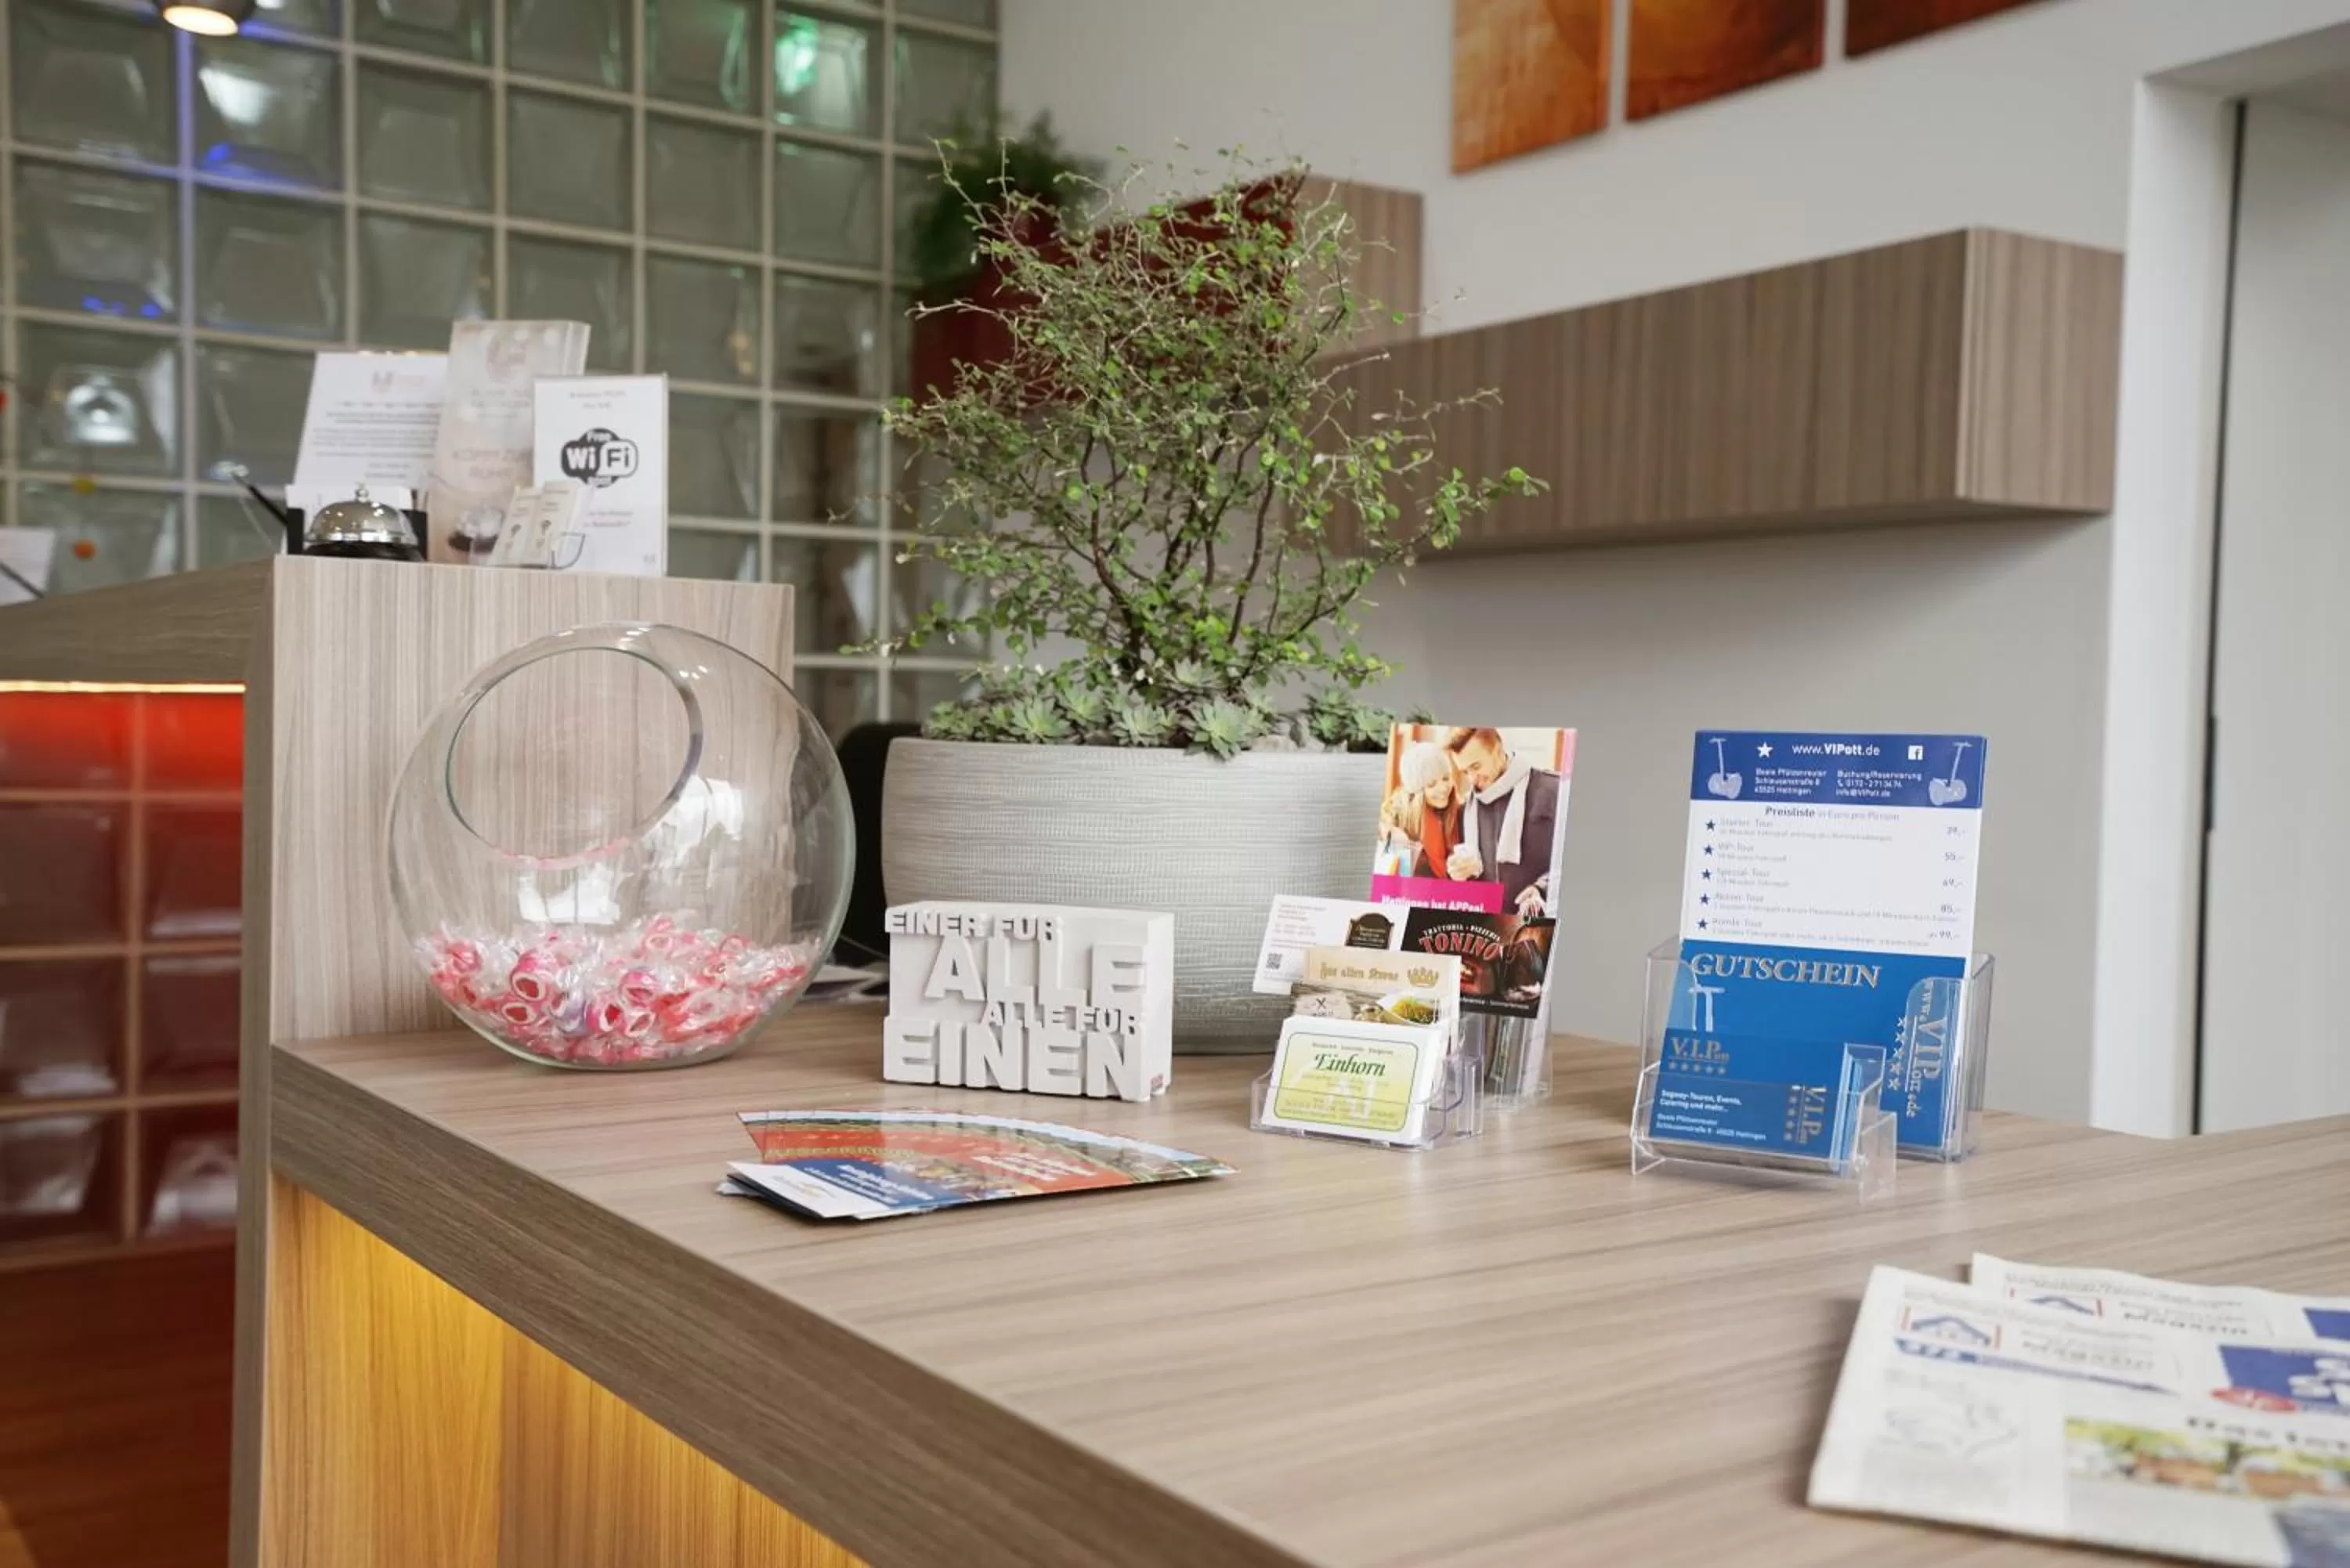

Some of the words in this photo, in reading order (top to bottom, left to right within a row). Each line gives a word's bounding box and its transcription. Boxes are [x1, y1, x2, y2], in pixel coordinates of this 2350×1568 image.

[1791, 742, 1881, 757] www.VIPott.de
[885, 907, 989, 938] EINER
[1419, 931, 1502, 962] TONINO
[924, 934, 1146, 1006] ALLE
[1690, 952, 1882, 989] GUTSCHEIN
[978, 1000, 1077, 1031] ALLE
[884, 1017, 1149, 1102] EINEN
[1314, 1052, 1386, 1077] Einhorn
